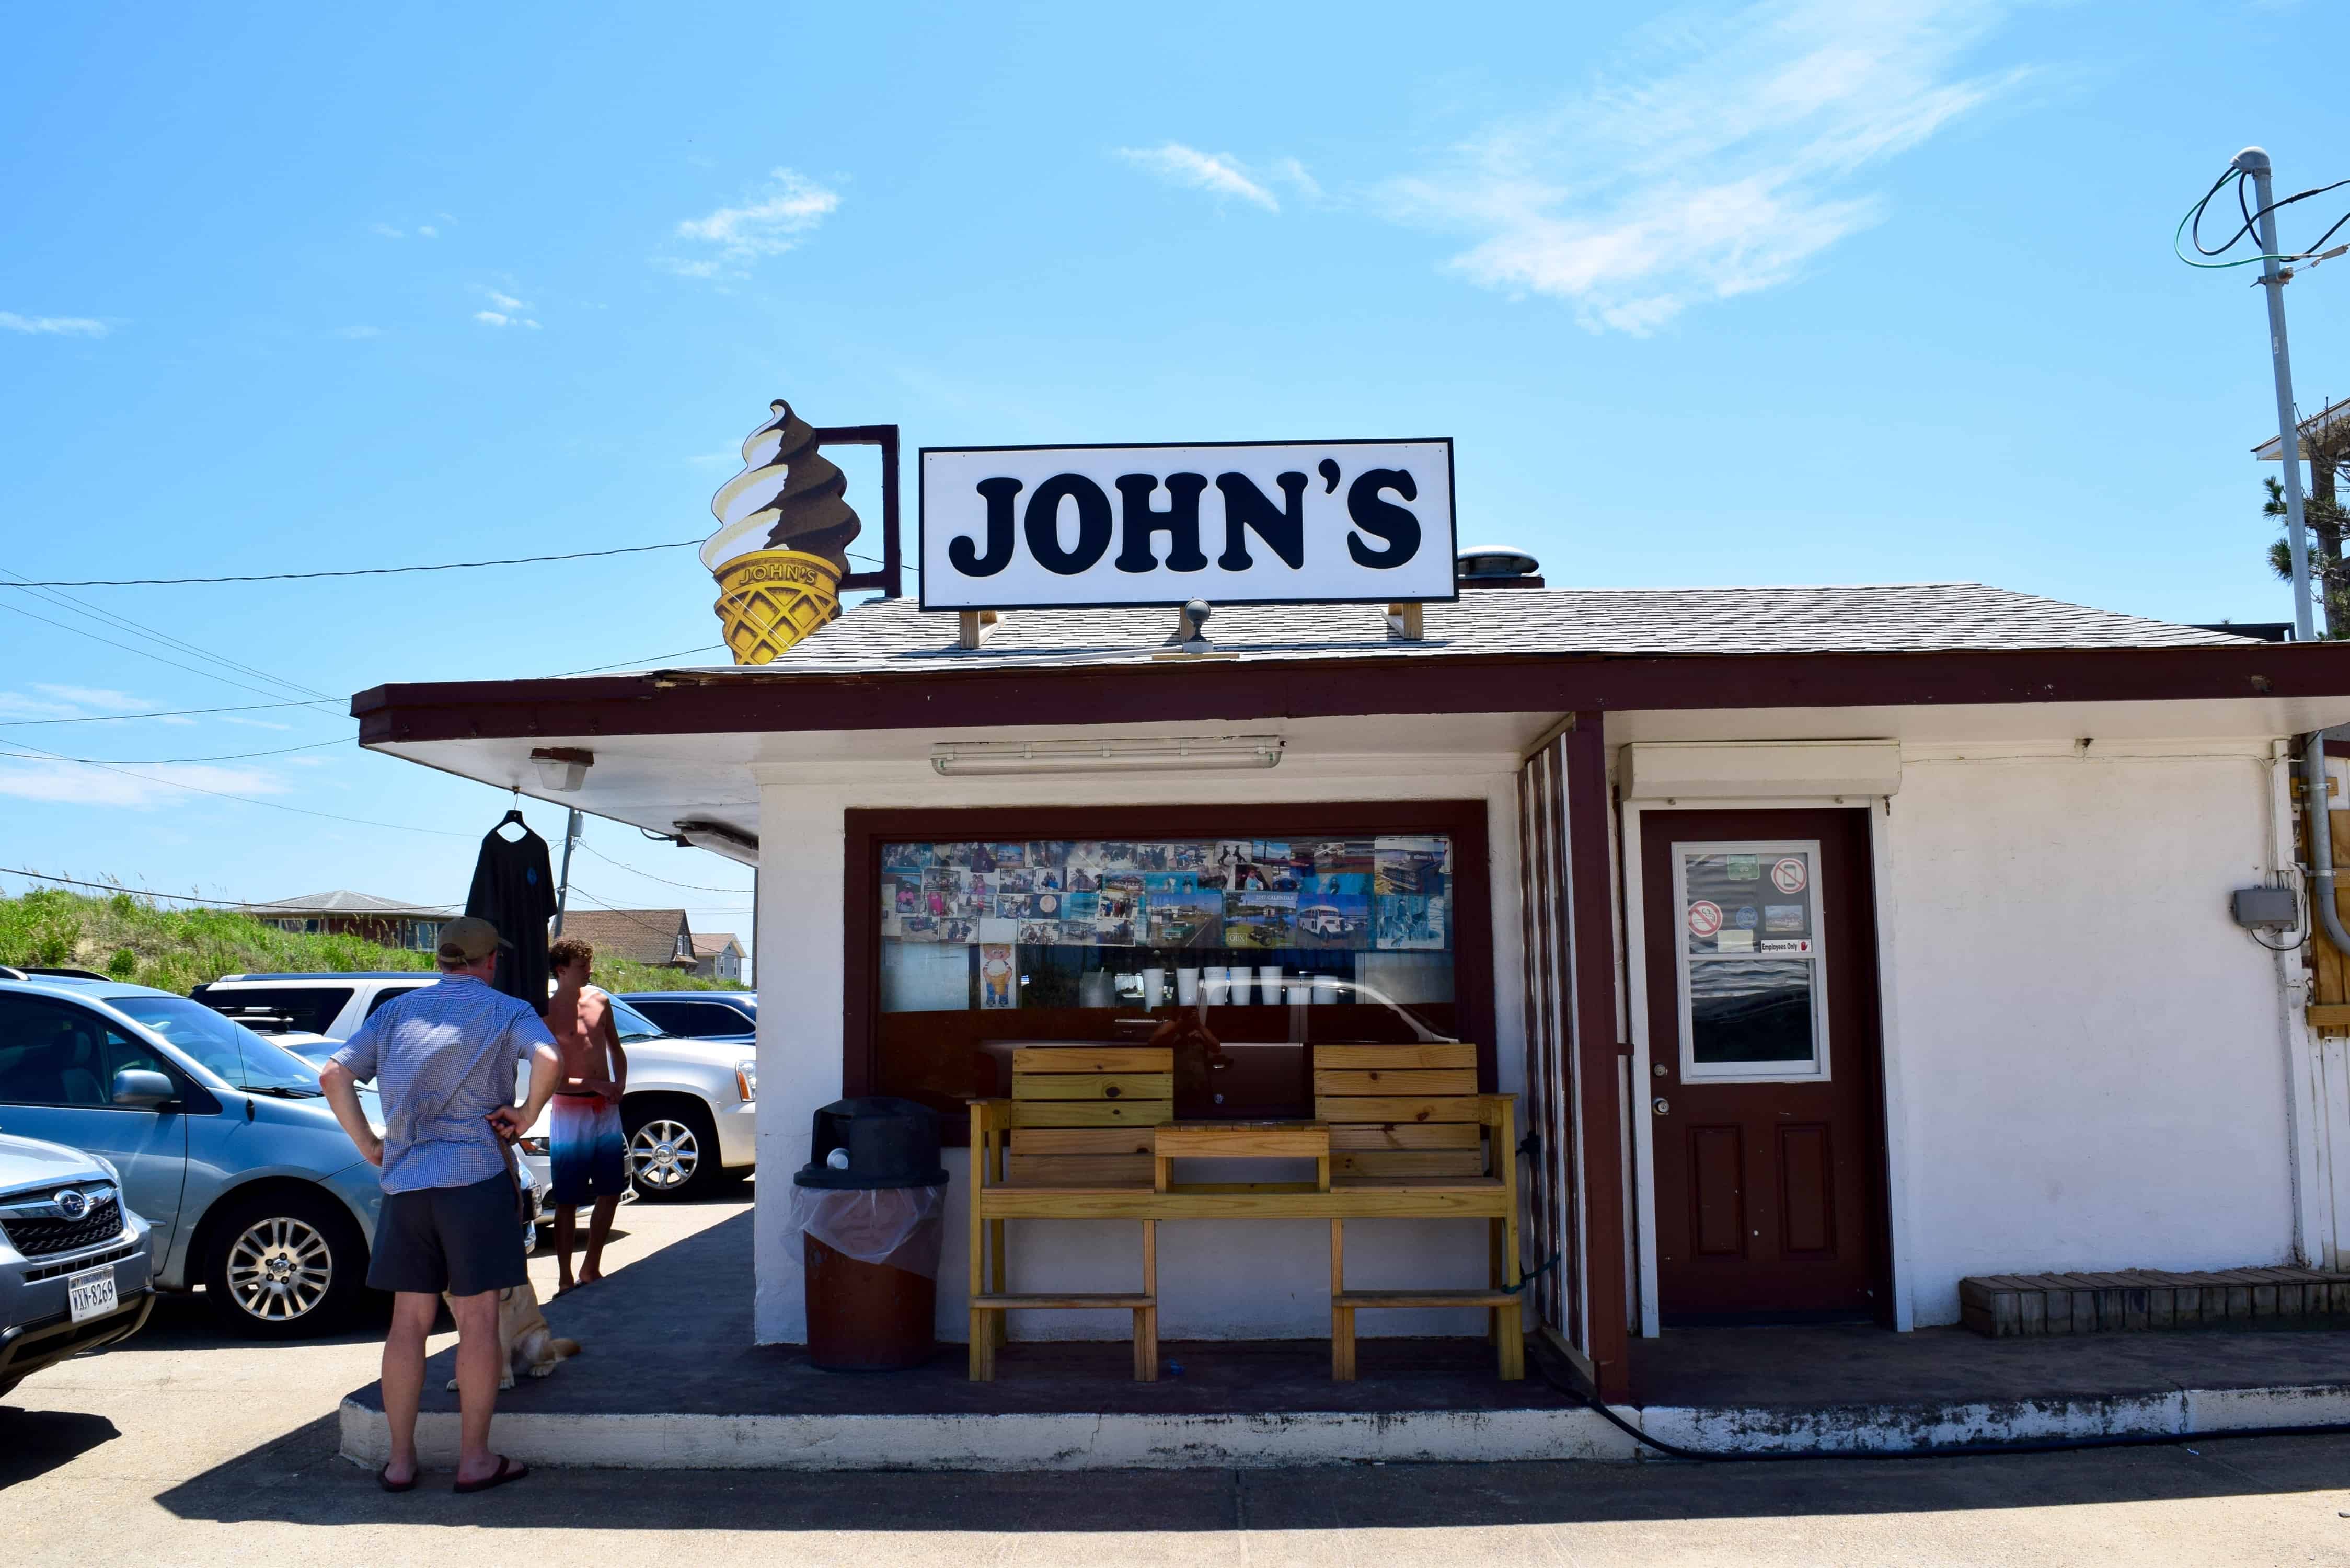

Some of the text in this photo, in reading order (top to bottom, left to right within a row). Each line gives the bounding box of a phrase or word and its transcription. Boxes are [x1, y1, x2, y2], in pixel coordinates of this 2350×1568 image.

[949, 459, 1421, 577] JOHN'S
[740, 564, 816, 585] JOHN'S
[72, 1280, 113, 1311] WXN-8269
